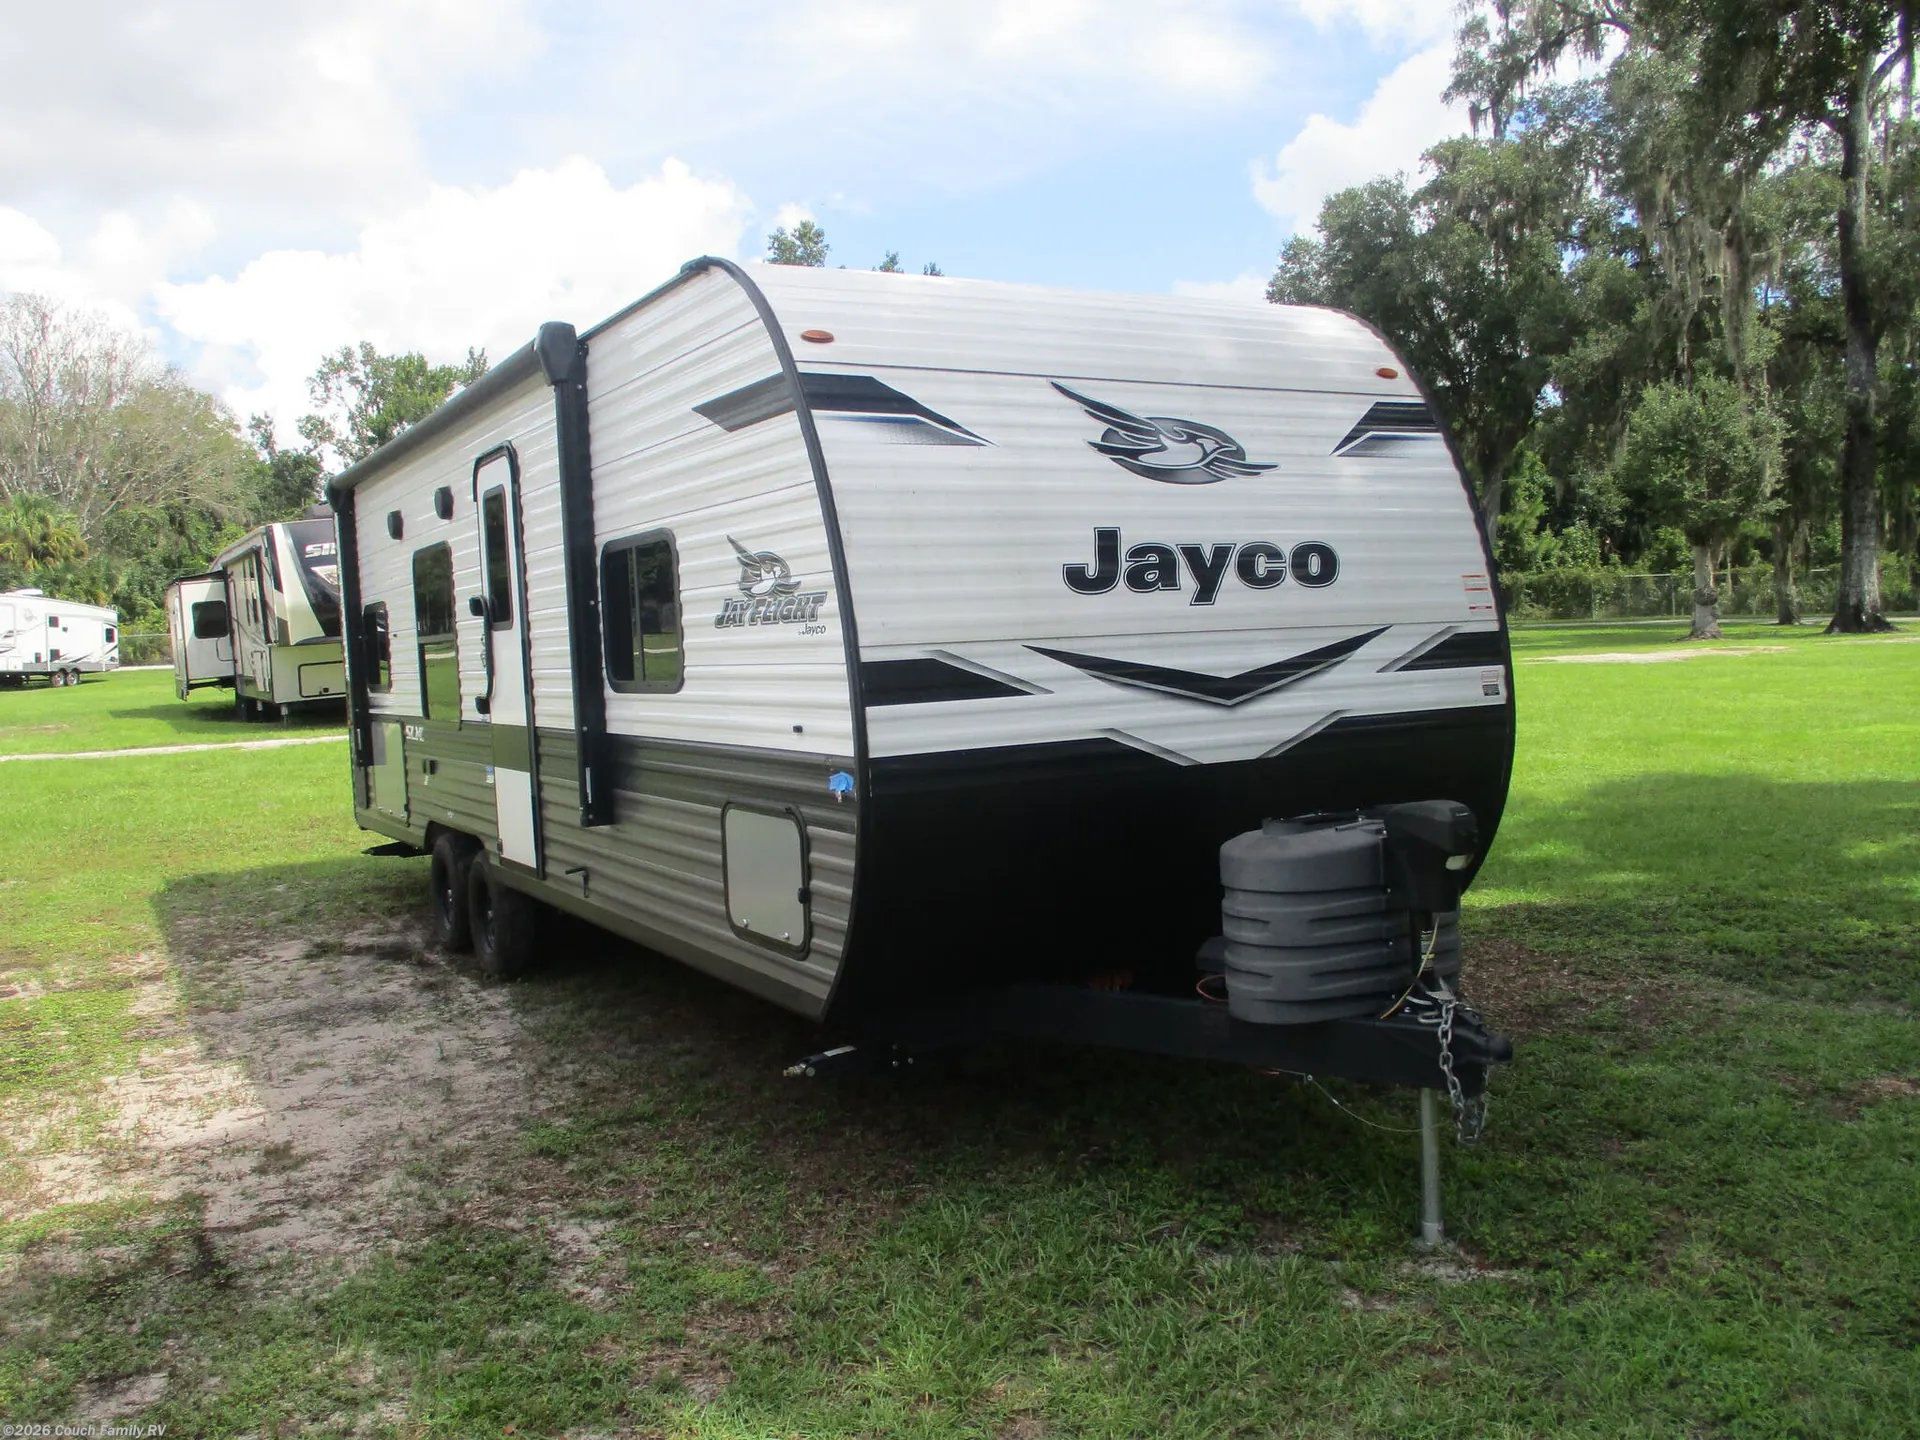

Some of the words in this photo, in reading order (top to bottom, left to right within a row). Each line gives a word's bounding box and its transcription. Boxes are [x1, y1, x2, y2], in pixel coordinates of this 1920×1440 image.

[1063, 527, 1340, 605] Jayco
[715, 598, 752, 629] JAY
[749, 591, 828, 626] FLIGHT
[802, 624, 826, 636] Jayco
